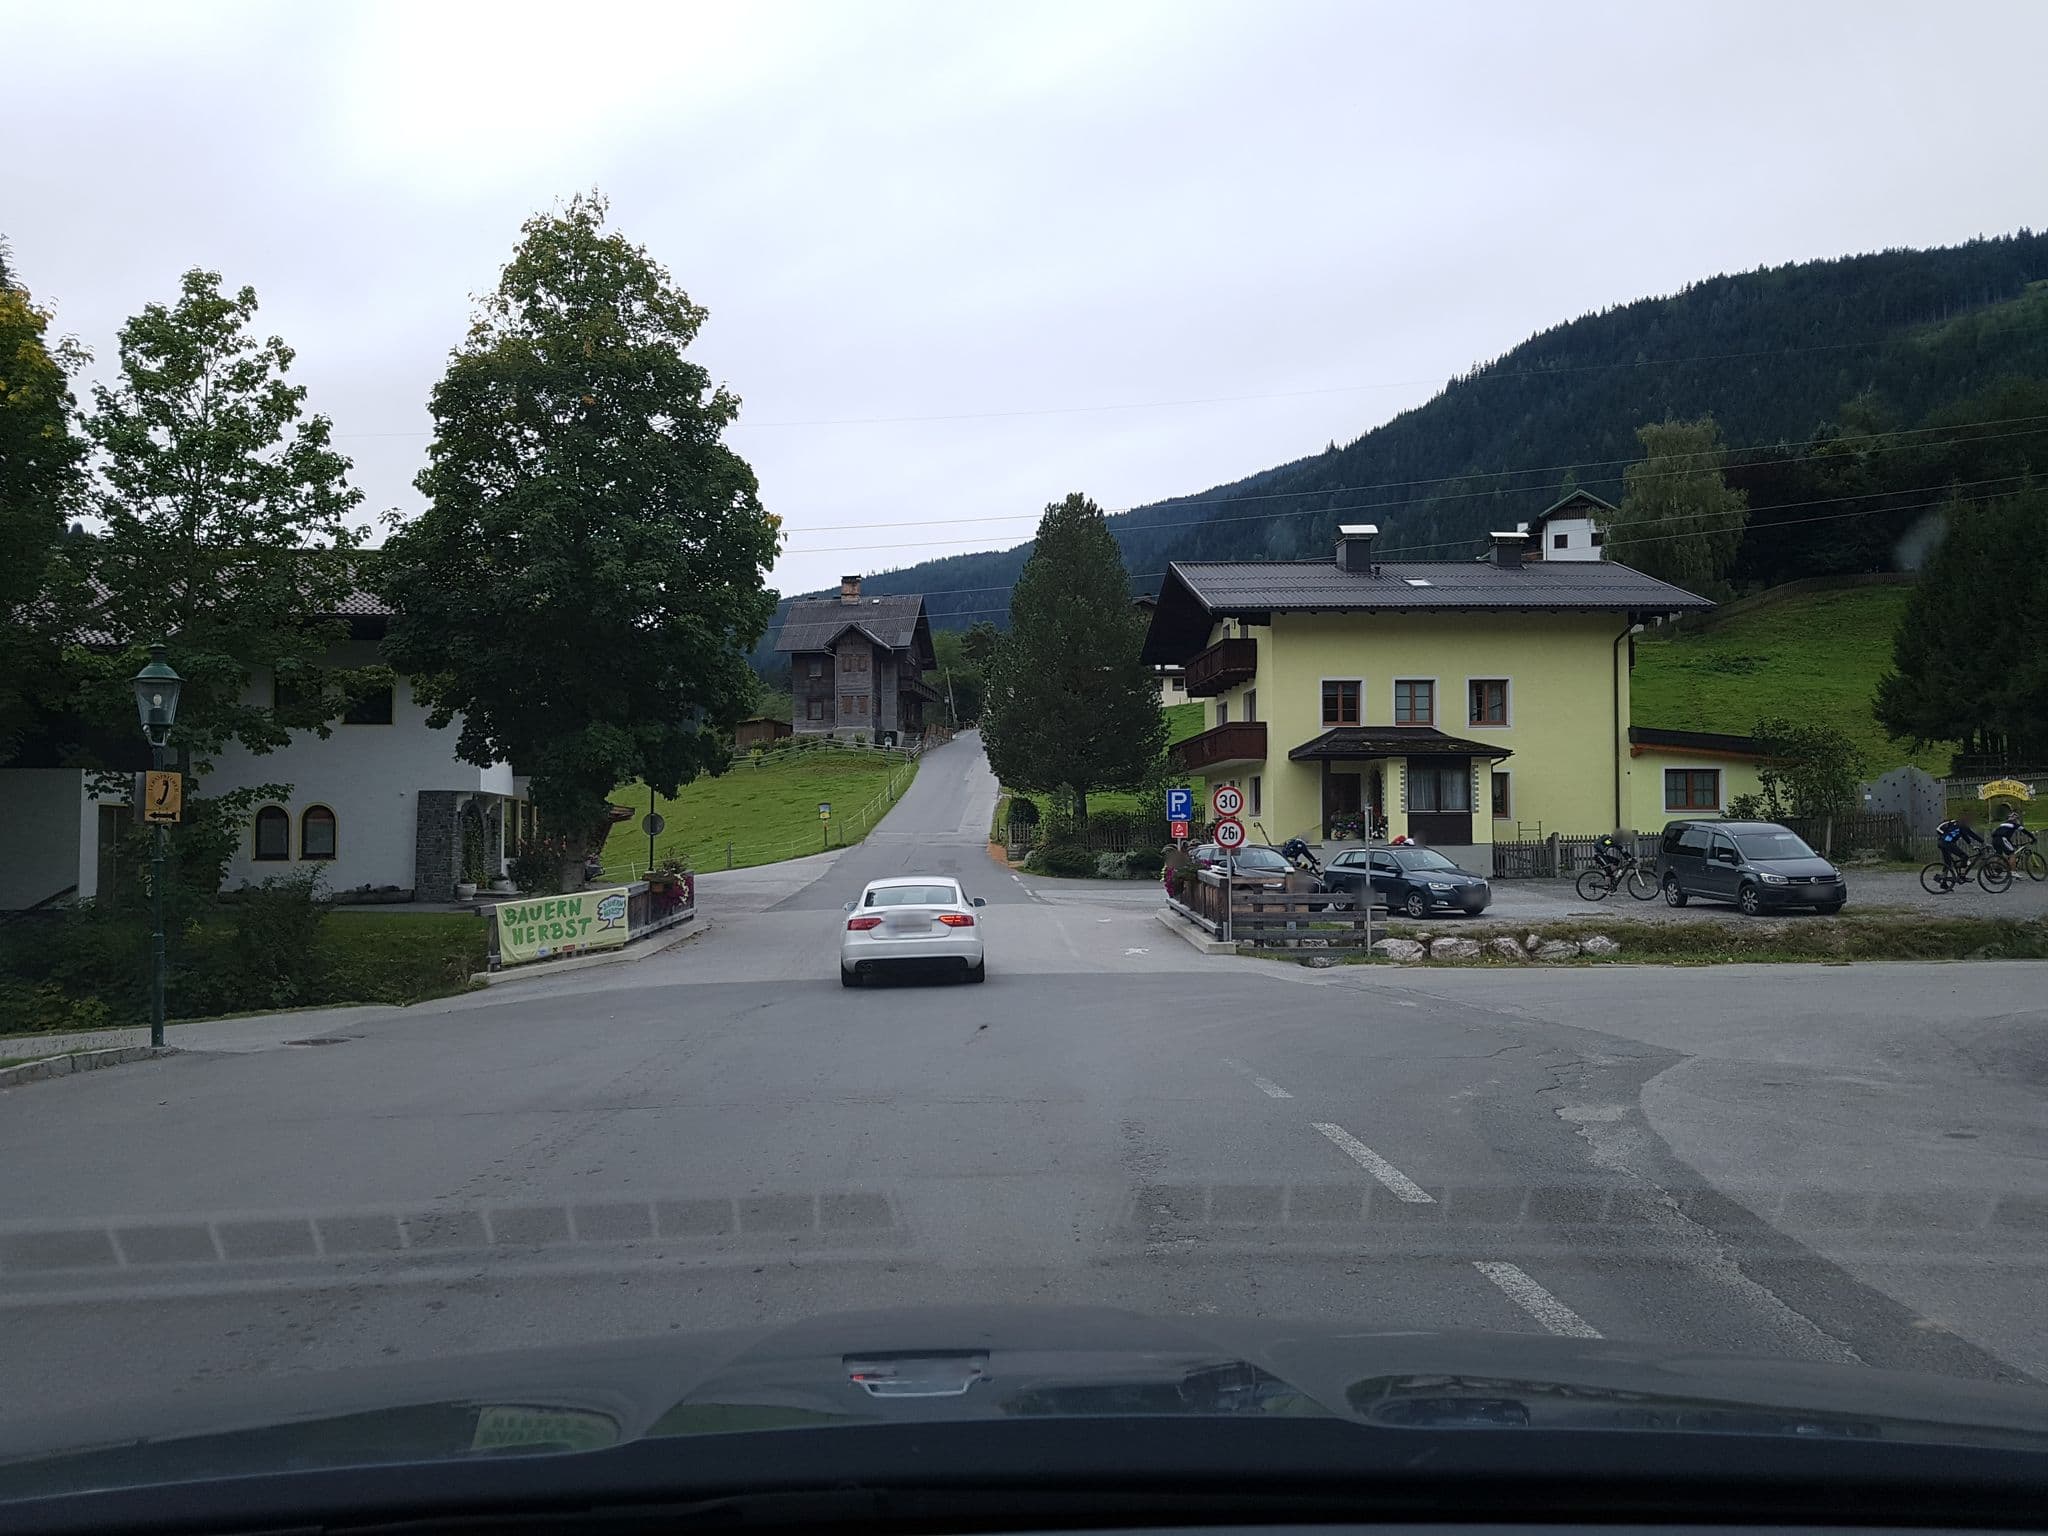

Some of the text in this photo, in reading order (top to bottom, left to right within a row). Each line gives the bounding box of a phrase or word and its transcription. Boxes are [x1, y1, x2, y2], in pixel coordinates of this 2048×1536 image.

[1171, 792, 1187, 812] P
[1219, 794, 1238, 809] 30
[502, 898, 582, 927] BAUERN
[512, 917, 592, 946] HERBST
